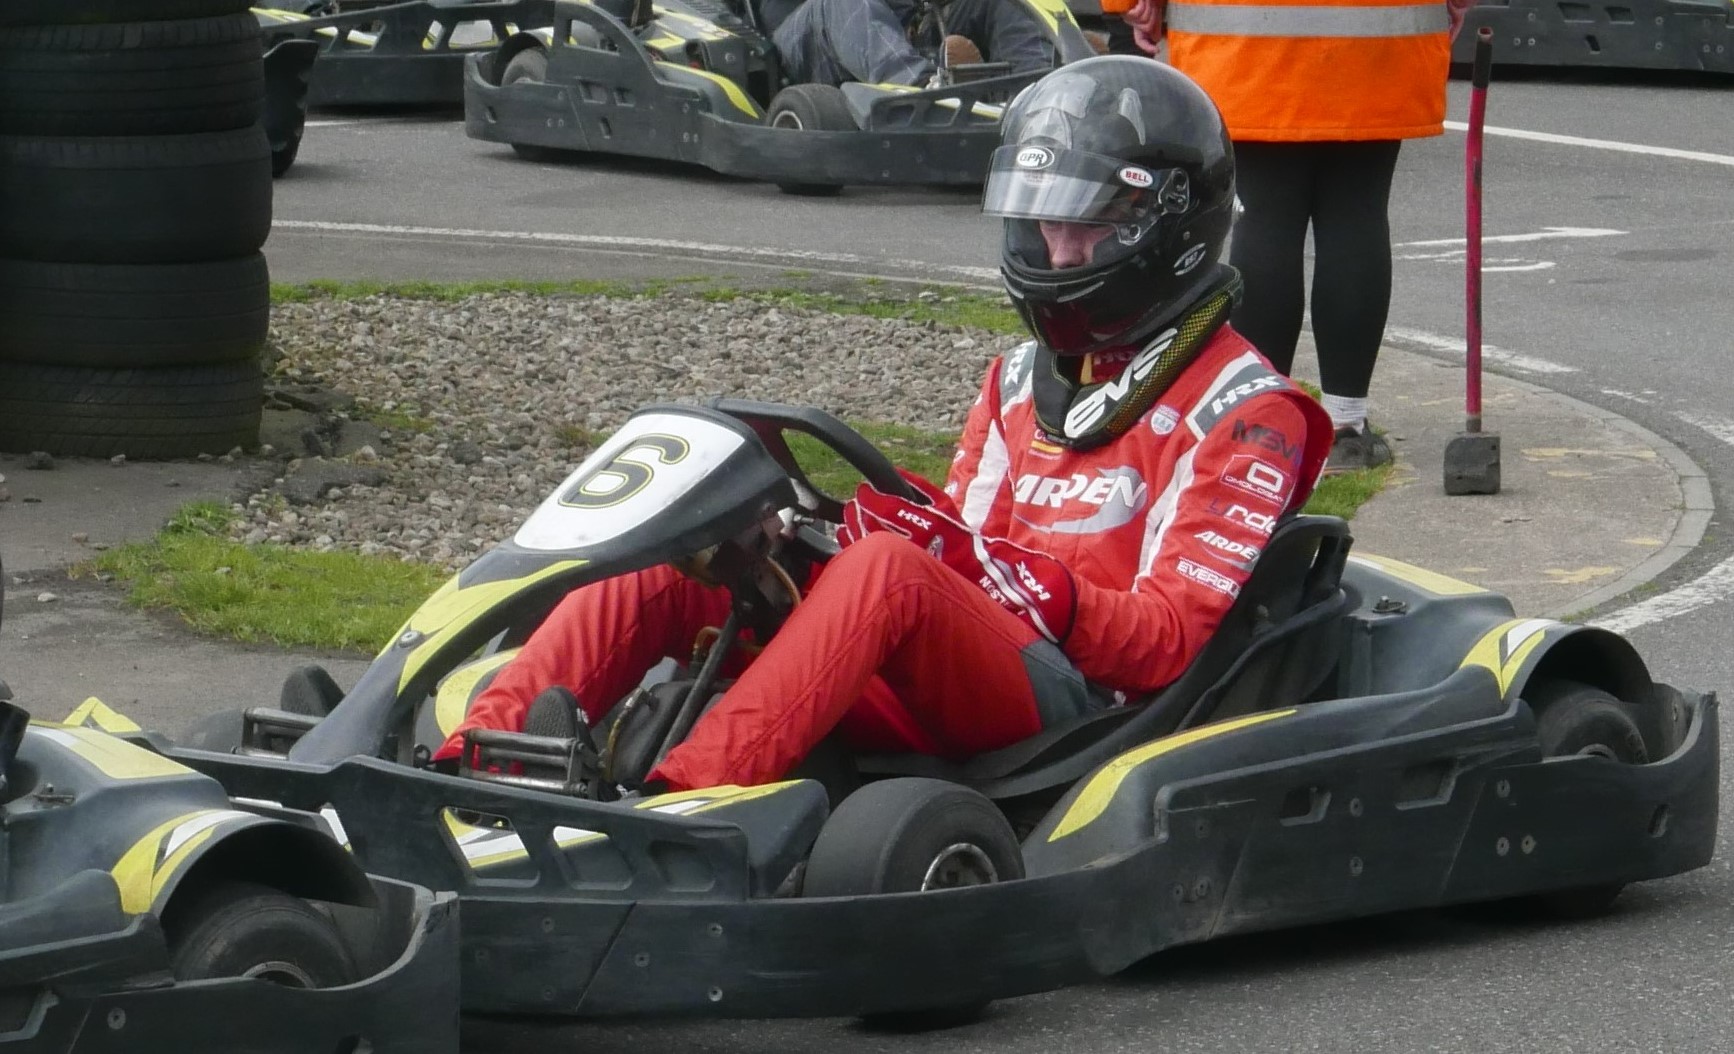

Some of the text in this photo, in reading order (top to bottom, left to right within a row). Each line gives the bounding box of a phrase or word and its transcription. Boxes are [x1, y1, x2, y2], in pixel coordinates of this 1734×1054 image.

[1126, 170, 1149, 183] BELL
[1064, 328, 1178, 438] EVS
[1211, 375, 1281, 415] HRX
[557, 433, 690, 509] 6
[897, 509, 933, 531] HRX
[1015, 561, 1052, 602] HRX
